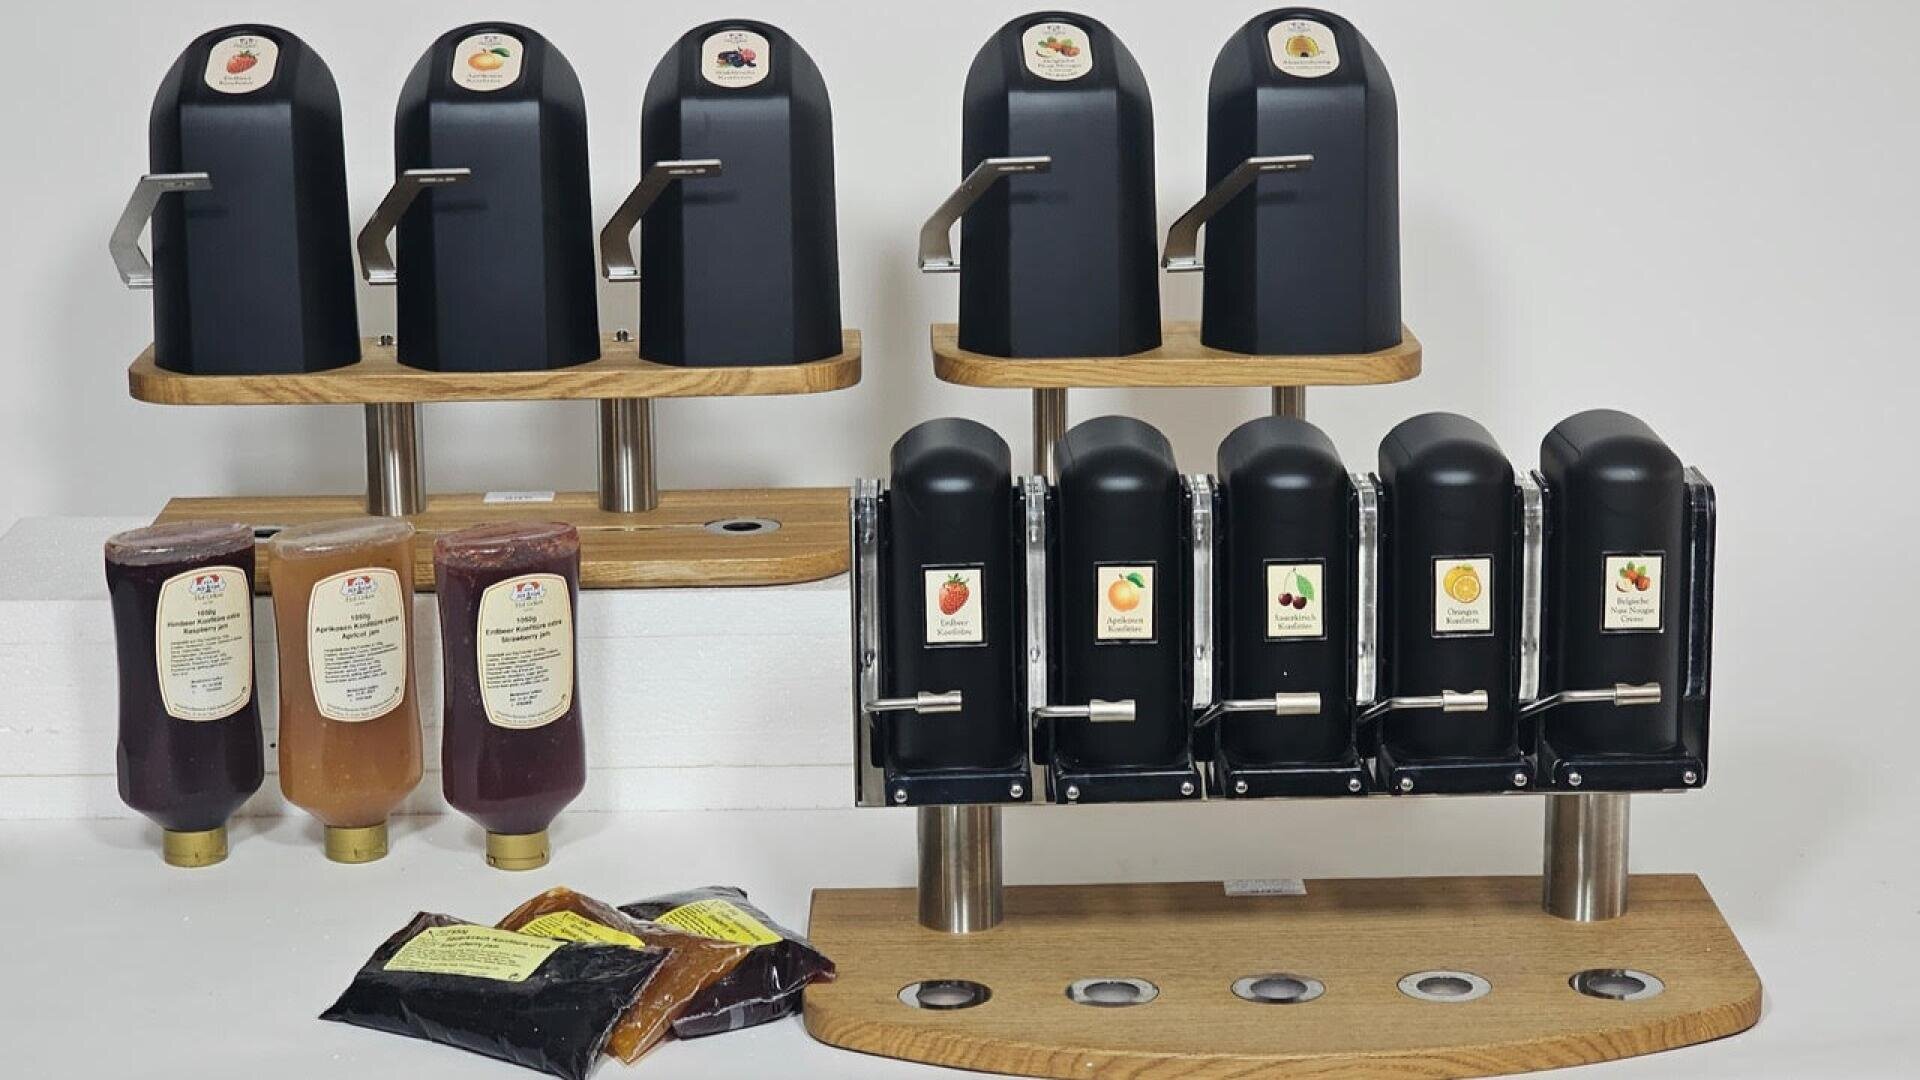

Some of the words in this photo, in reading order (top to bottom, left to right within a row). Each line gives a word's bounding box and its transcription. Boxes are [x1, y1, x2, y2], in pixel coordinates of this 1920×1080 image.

[1616, 596, 1649, 606] Belgische
[1446, 608, 1480, 617] Orangen
[1106, 616, 1144, 625] Aprikosen
[183, 625, 217, 635] Raspberry
[315, 625, 353, 635] Aprikosen
[341, 630, 368, 640] Apricot
[485, 628, 515, 636] Erdbeer
[501, 631, 539, 643] Strawberry
